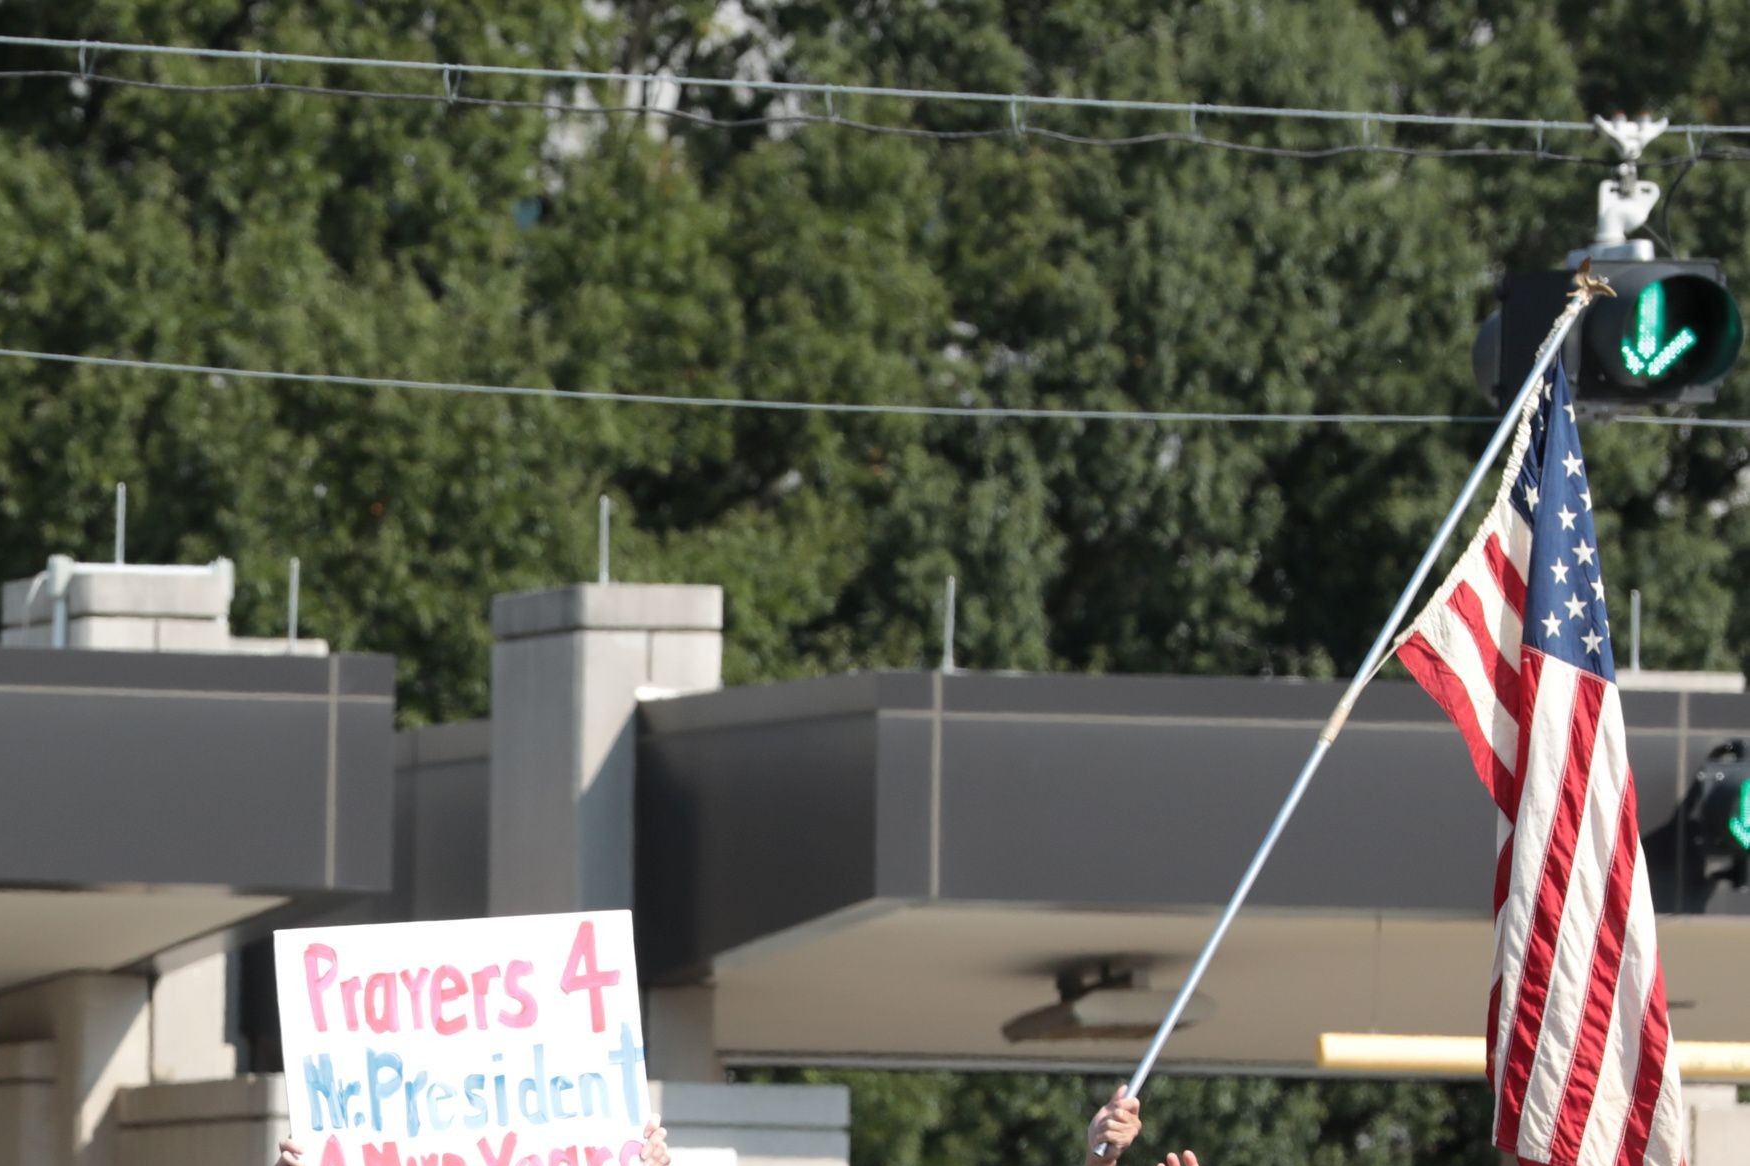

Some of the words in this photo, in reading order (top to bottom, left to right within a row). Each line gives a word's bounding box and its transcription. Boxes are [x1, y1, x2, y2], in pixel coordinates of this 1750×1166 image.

[304, 943, 539, 1036] Prayers
[560, 920, 621, 1034] 4
[366, 1022, 645, 1138] President
